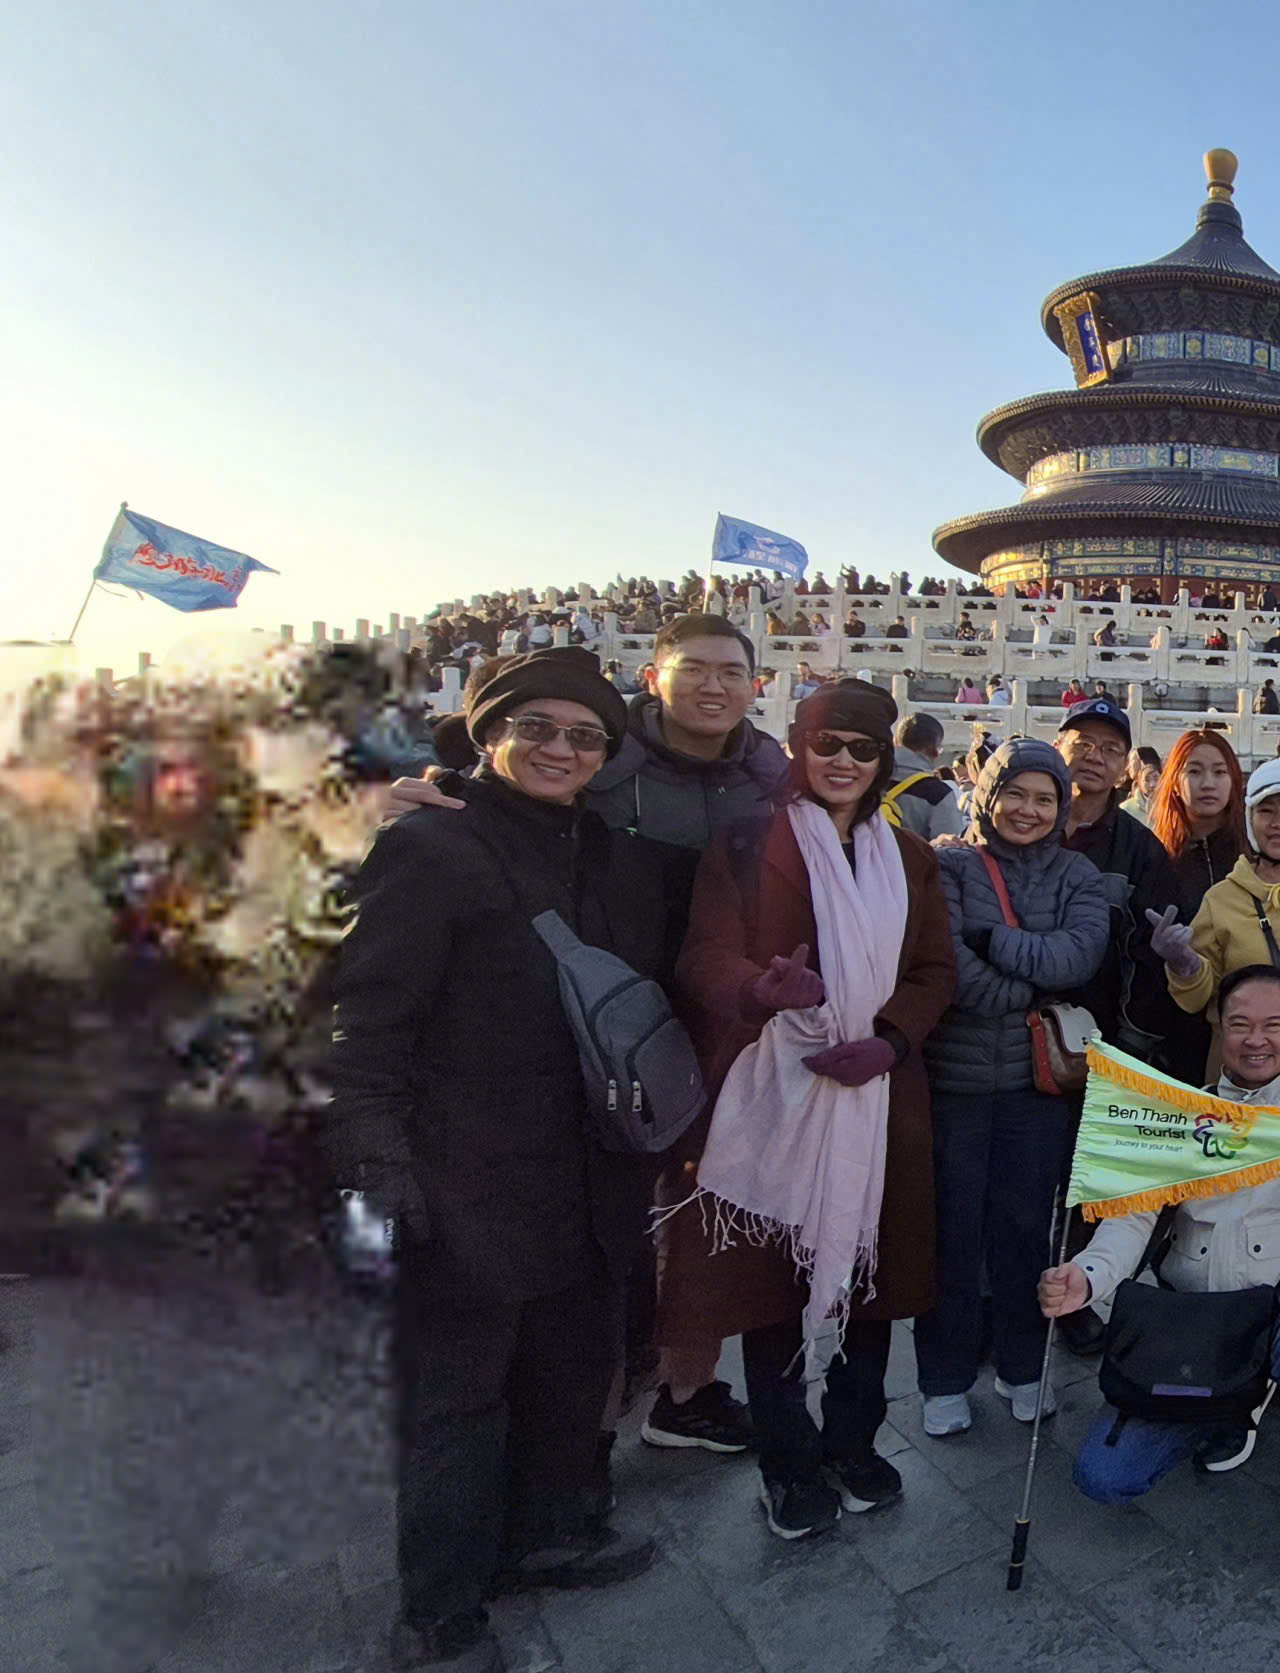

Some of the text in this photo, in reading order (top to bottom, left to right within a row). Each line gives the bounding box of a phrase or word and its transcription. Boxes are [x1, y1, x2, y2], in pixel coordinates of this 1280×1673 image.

[1108, 1104, 1188, 1125] Ben Thanh
[1134, 1125, 1186, 1140] Tourist
